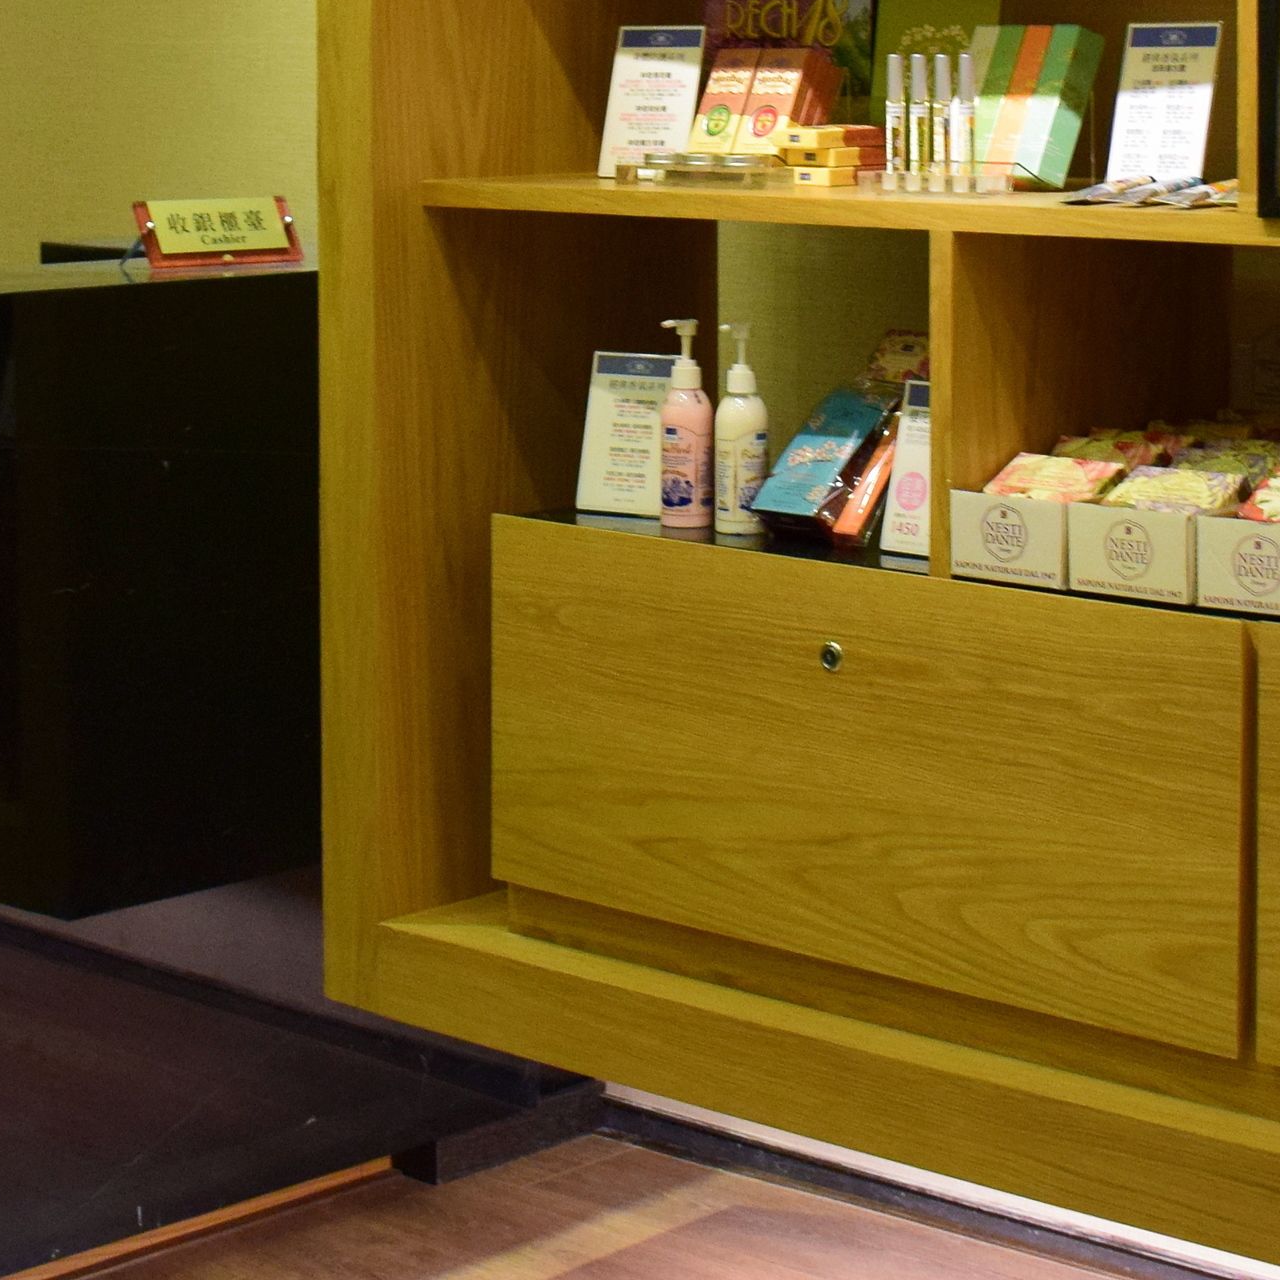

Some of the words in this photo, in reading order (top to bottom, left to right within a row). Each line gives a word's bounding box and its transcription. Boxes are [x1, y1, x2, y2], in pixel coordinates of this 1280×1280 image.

[200, 232, 248, 246] Cashier
[985, 520, 1023, 536] NESTI
[985, 532, 1023, 548] DANTE
[1108, 536, 1148, 553] NESTI
[1108, 548, 1149, 565] DANTE
[1238, 552, 1280, 569] NESTI
[1238, 564, 1280, 581] DANTE
